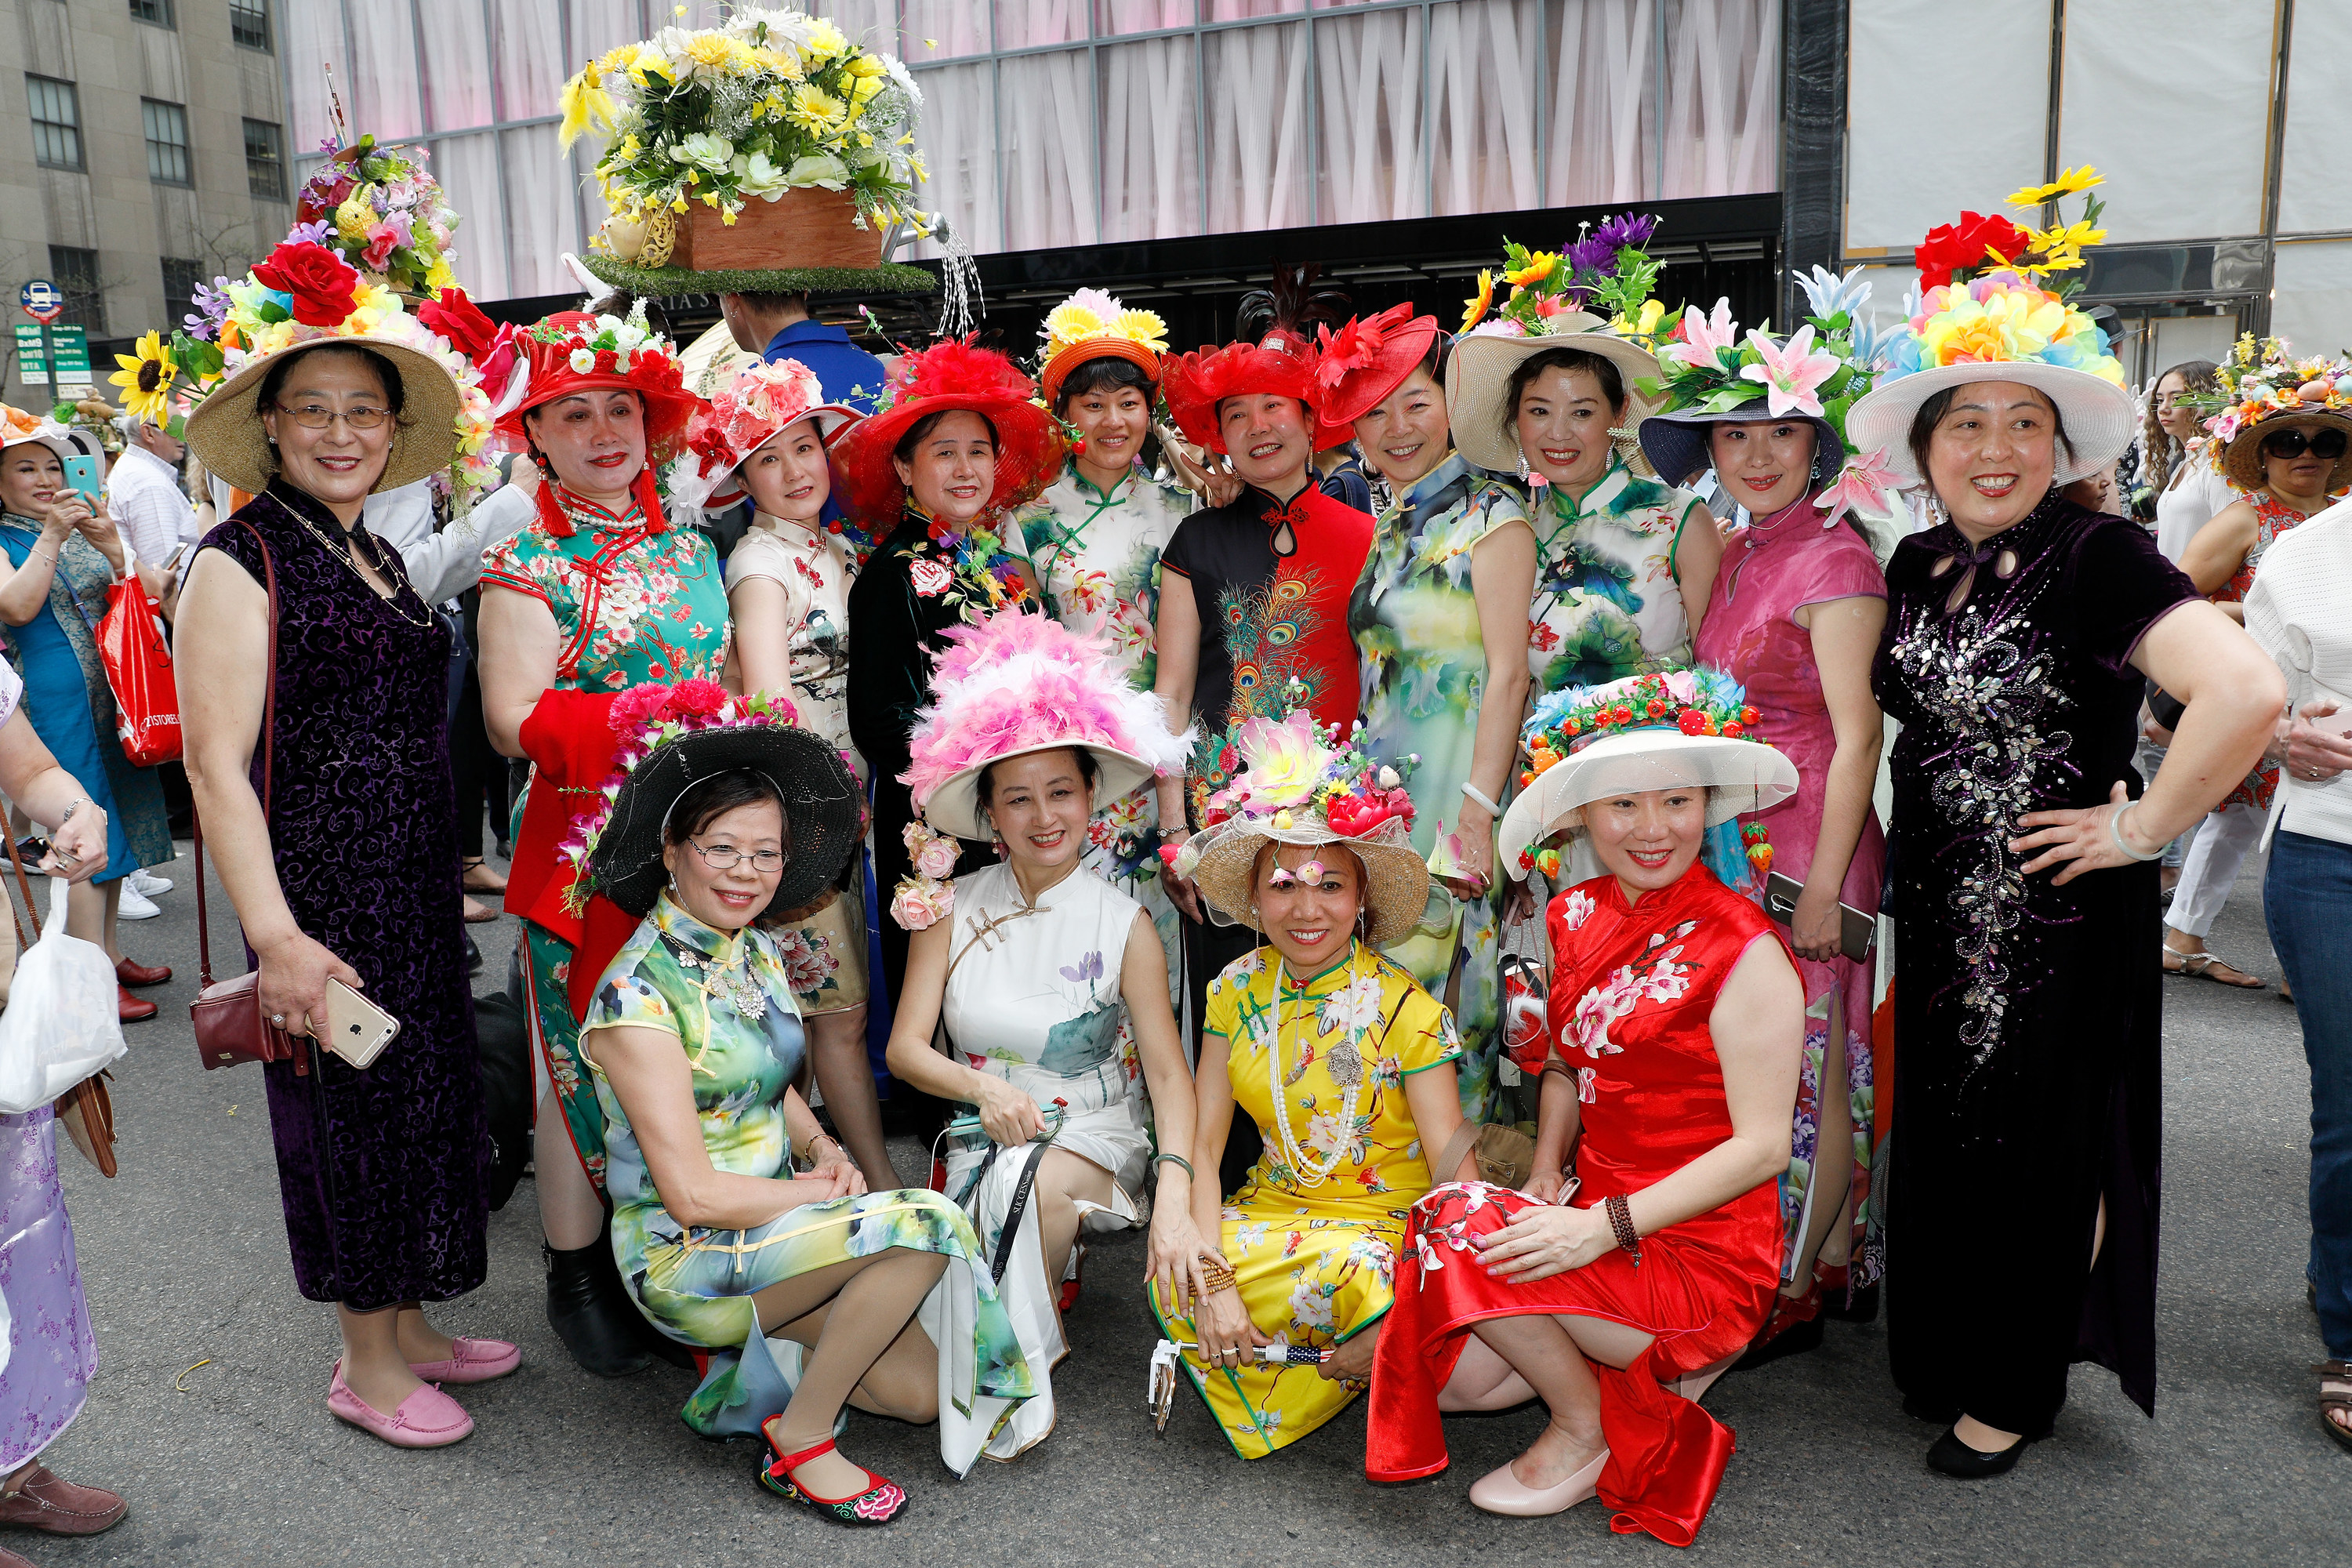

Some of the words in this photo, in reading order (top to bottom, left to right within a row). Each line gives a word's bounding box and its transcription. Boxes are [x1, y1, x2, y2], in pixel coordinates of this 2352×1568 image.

[34, 306, 60, 318] STANDING
[17, 338, 42, 347] BxM9
[1013, 1180, 1029, 1214] SUCCESS
